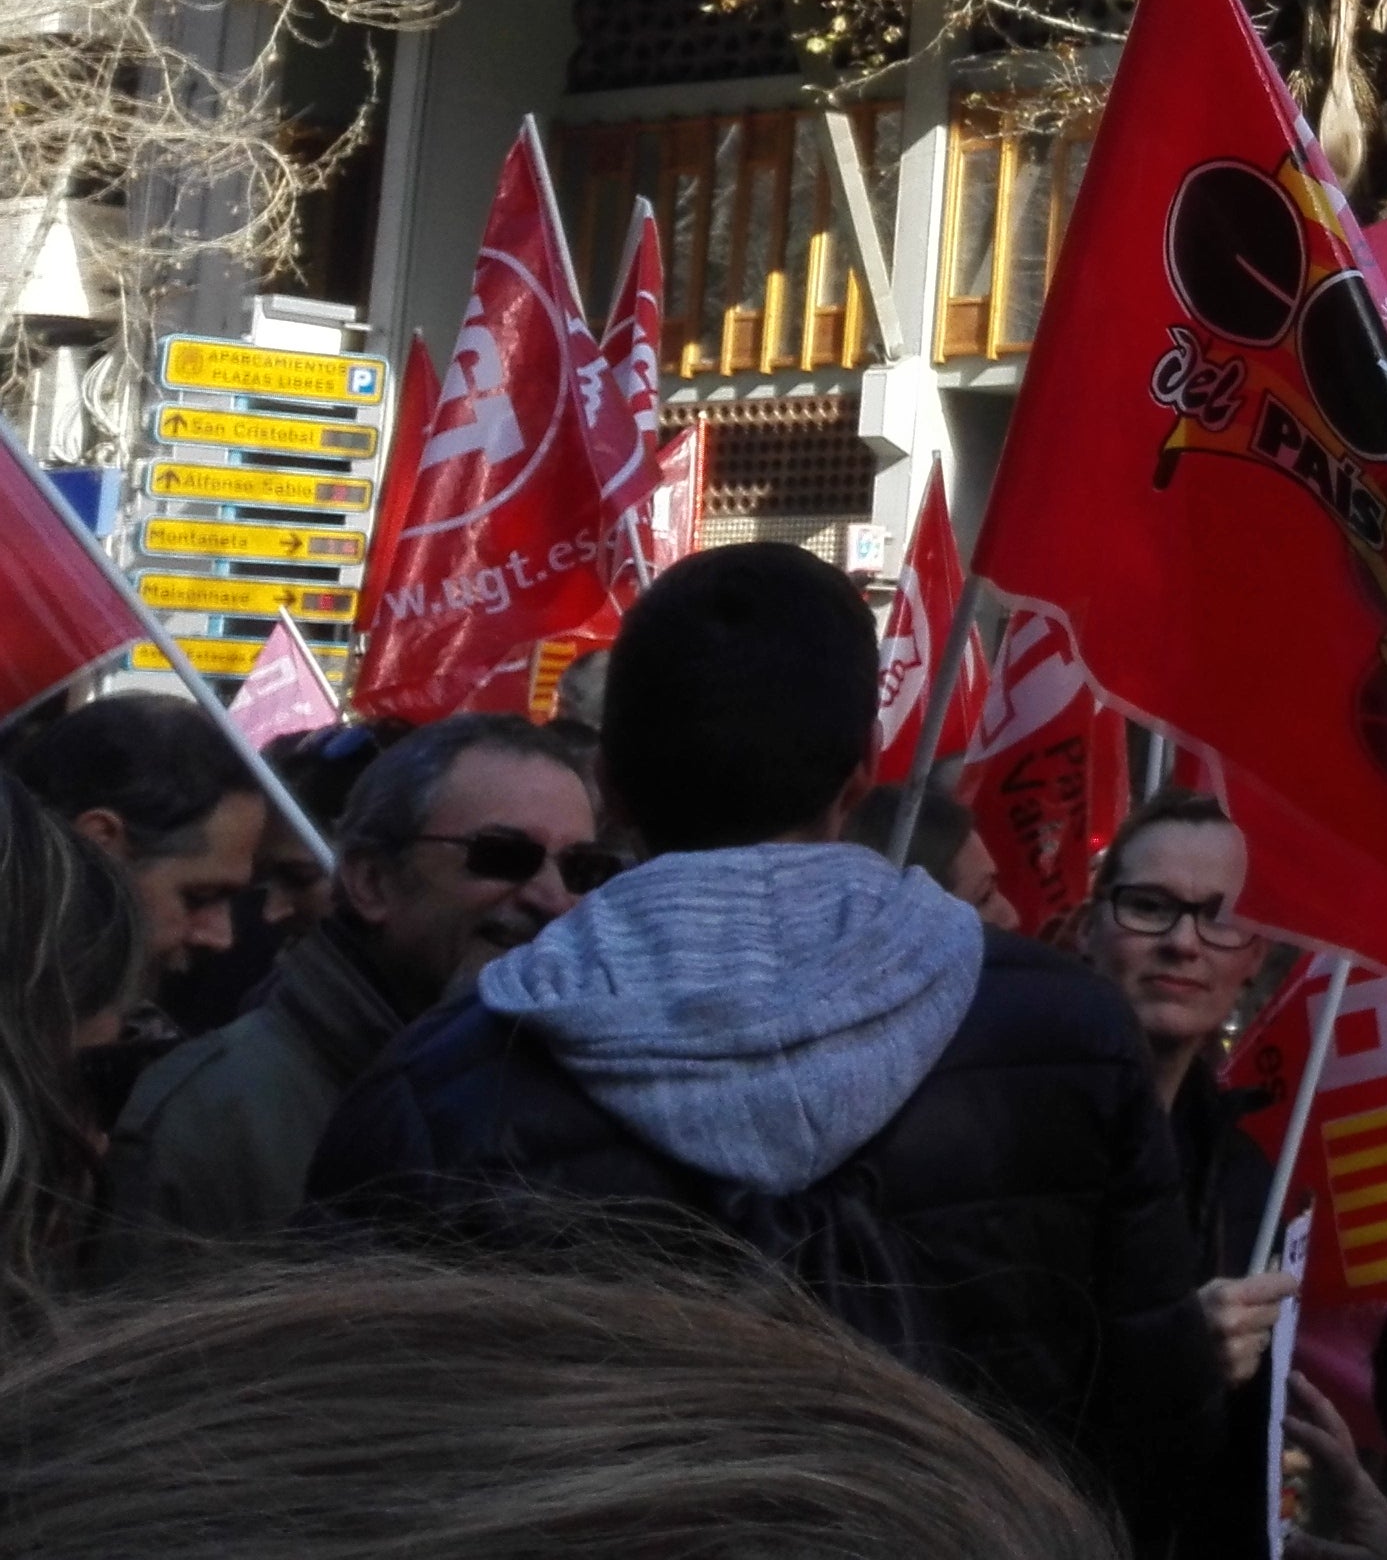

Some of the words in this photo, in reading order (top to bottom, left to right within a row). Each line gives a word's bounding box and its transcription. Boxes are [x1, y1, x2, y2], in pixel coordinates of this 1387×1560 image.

[207, 350, 348, 375] APARCAMIENTOS
[212, 369, 272, 386] PLAZAS
[278, 376, 336, 393] LIBRES
[1149, 325, 1246, 432] del
[191, 415, 226, 433] San
